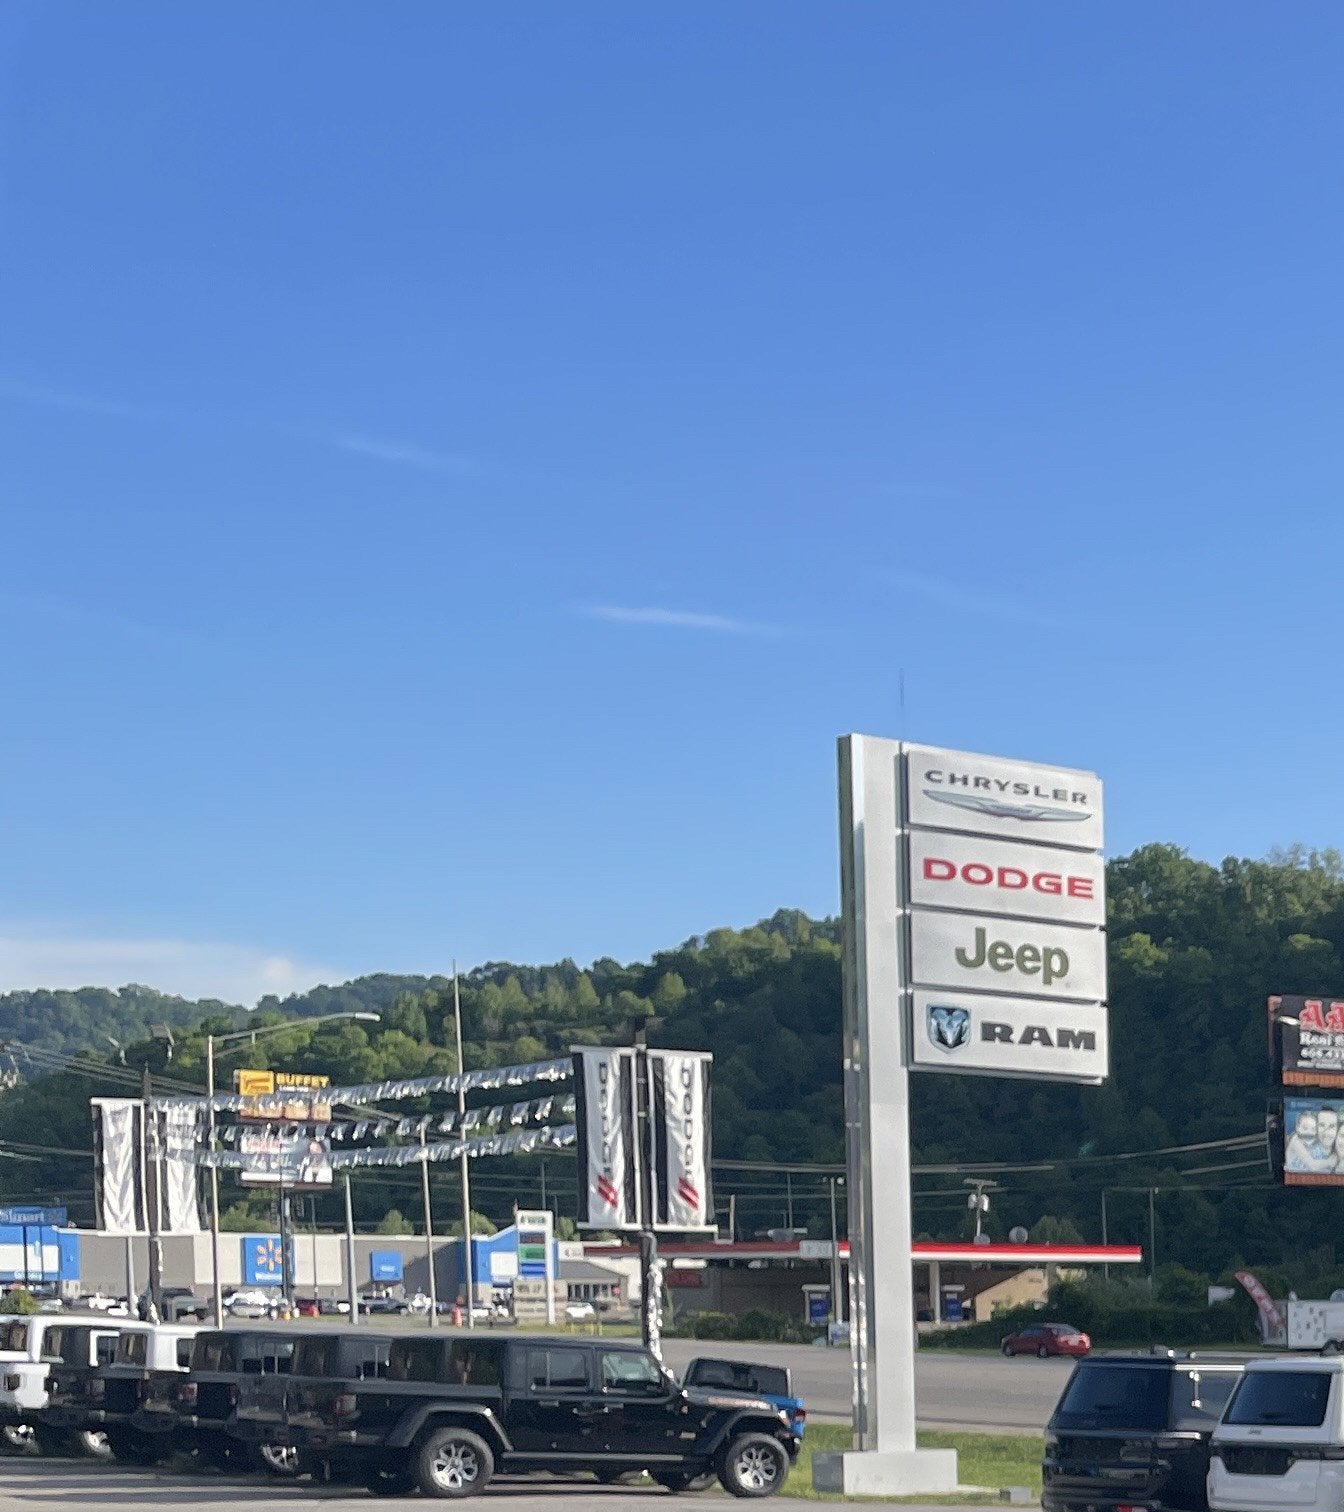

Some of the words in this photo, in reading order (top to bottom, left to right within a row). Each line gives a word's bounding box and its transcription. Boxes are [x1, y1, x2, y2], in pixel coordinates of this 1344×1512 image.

[924, 769, 1089, 805] CHRYSLER
[923, 857, 1094, 899] DODGE
[955, 927, 1069, 984] Jeep
[980, 1021, 1096, 1051] RAM
